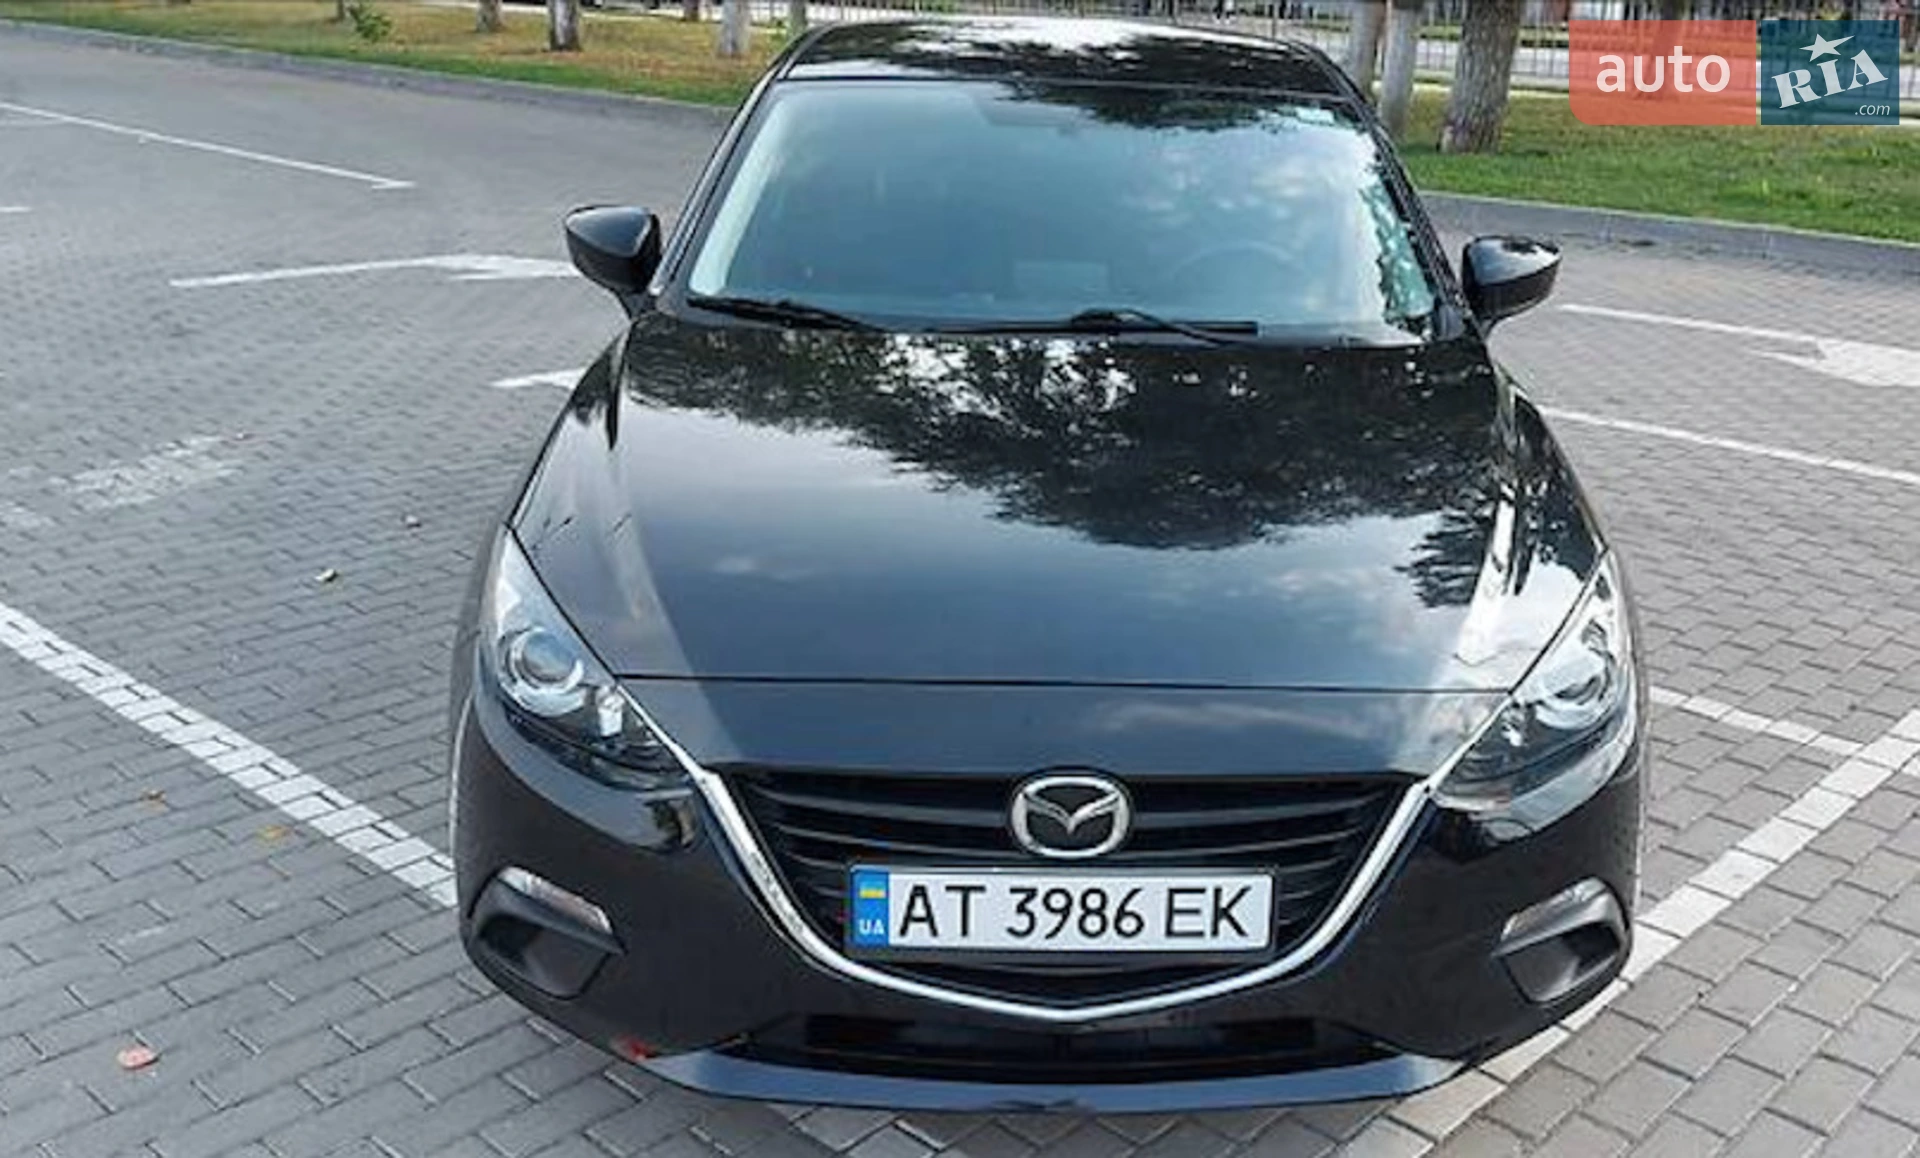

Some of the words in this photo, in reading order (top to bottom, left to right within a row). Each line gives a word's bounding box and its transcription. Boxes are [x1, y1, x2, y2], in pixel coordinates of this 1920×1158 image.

[858, 918, 885, 936] UA
[900, 885, 986, 938] AT
[1006, 886, 1145, 939] 3986
[1164, 885, 1252, 938] EK
